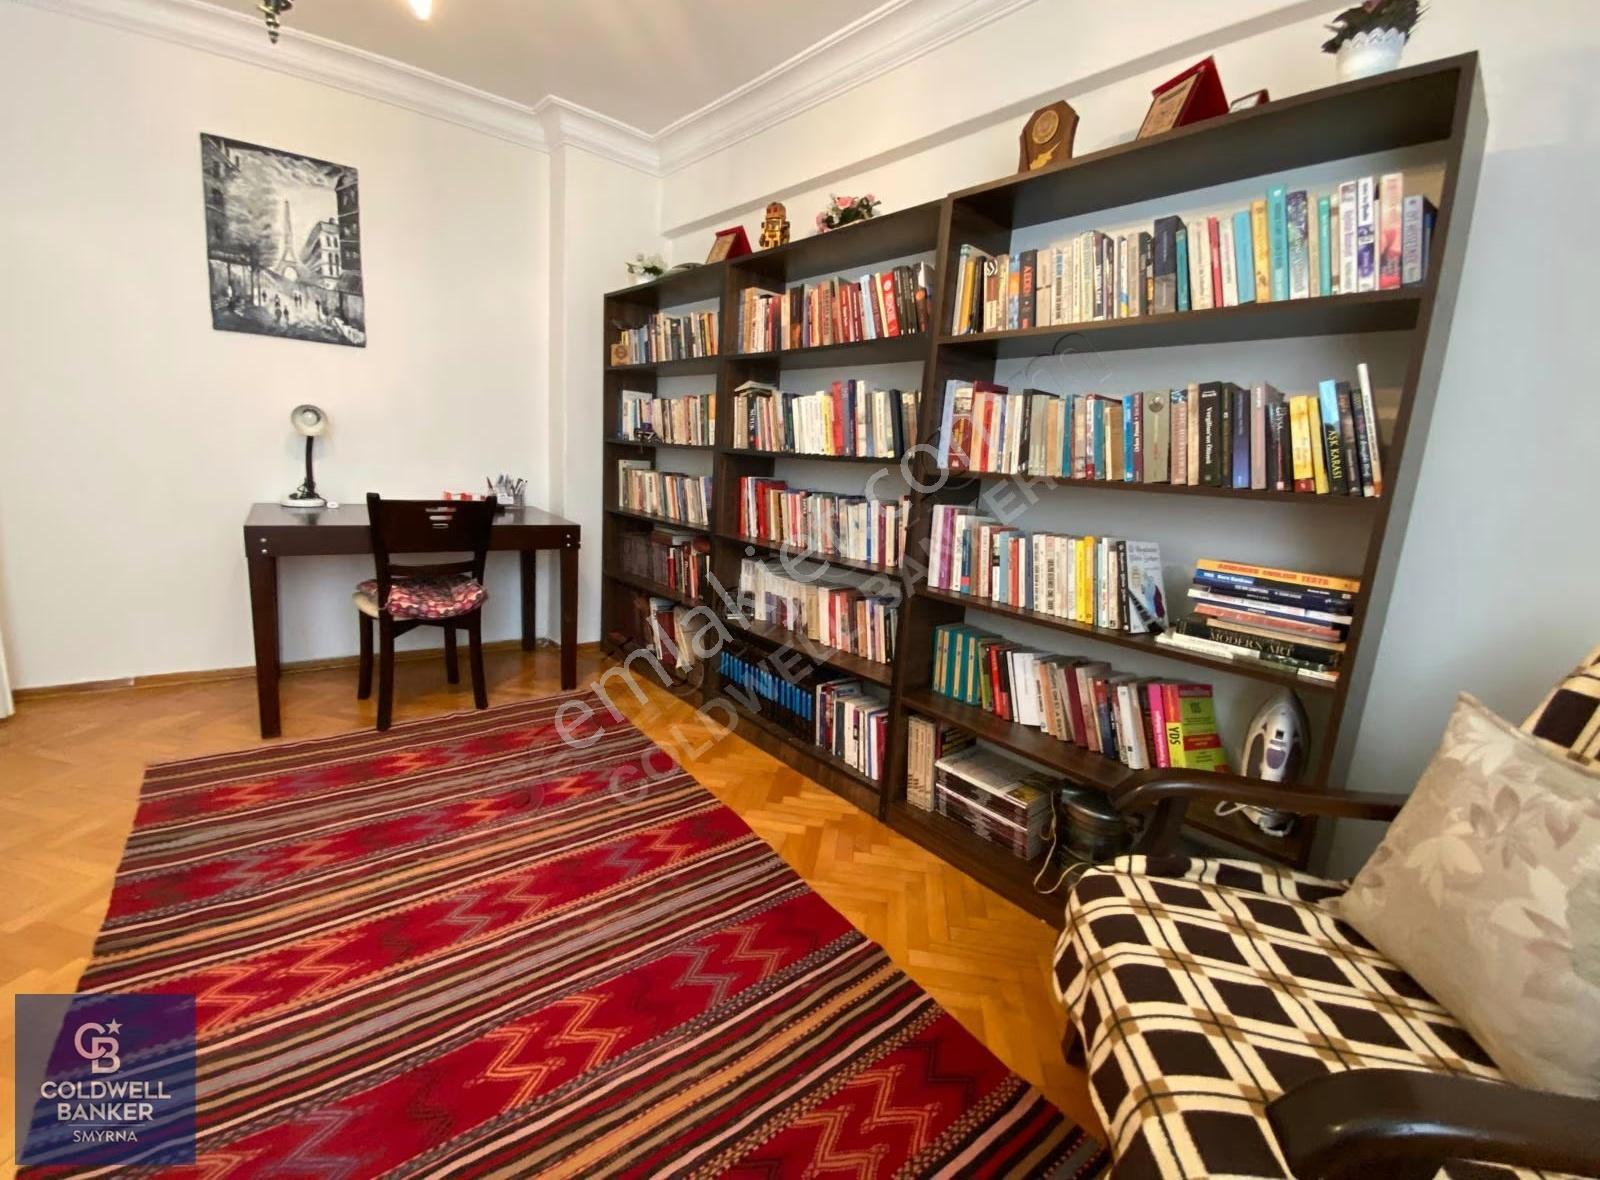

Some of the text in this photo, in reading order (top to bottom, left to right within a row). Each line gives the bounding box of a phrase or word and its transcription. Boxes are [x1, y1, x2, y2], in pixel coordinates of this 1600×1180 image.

[1209, 630, 1295, 657] MODERN ART
[1169, 725, 1181, 745] YDS
